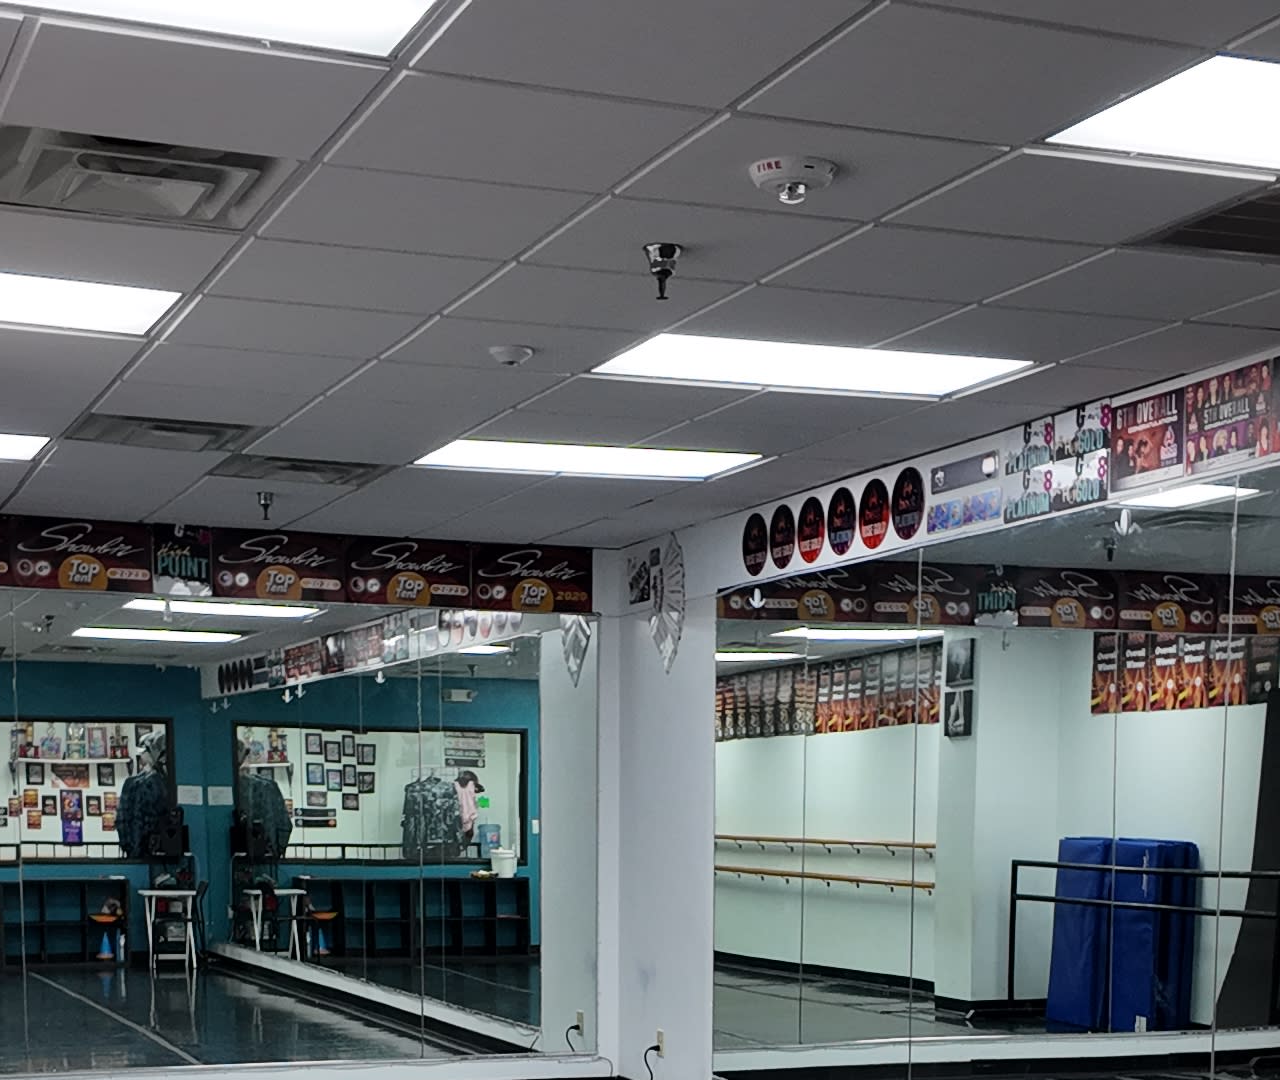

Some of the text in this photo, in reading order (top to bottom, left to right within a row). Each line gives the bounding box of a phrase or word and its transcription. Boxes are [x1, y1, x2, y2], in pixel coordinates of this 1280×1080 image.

[17, 522, 145, 557] Showbiz
[218, 534, 337, 568] Showbiz
[70, 559, 101, 576] Top
[157, 555, 209, 579] POINT
[351, 541, 464, 574] Showbiz
[478, 550, 588, 580] Showbiz
[267, 570, 296, 586] Top
[397, 575, 425, 591] Top
[522, 583, 549, 599] Top
